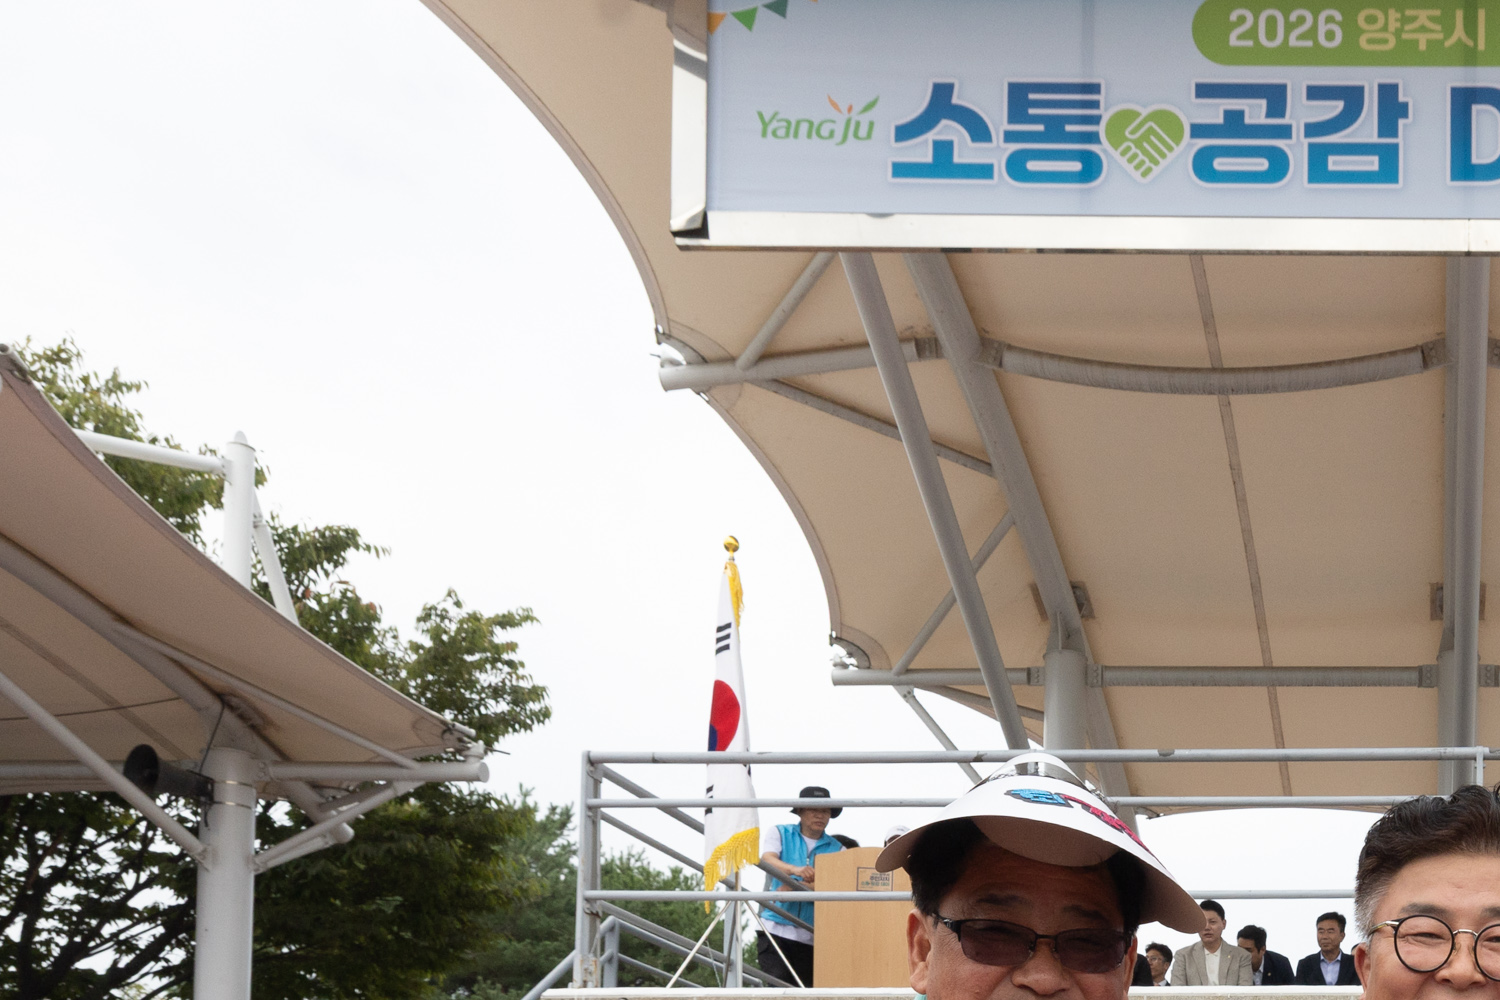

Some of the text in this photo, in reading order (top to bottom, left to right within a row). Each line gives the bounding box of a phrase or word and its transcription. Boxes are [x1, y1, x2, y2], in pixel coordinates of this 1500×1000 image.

[1228, 8, 1343, 48] 2026
[1357, 8, 1486, 50] 양주시
[756, 104, 875, 146] Yangju
[889, 80, 1104, 186] 소통
[1188, 80, 1411, 186] 공감
